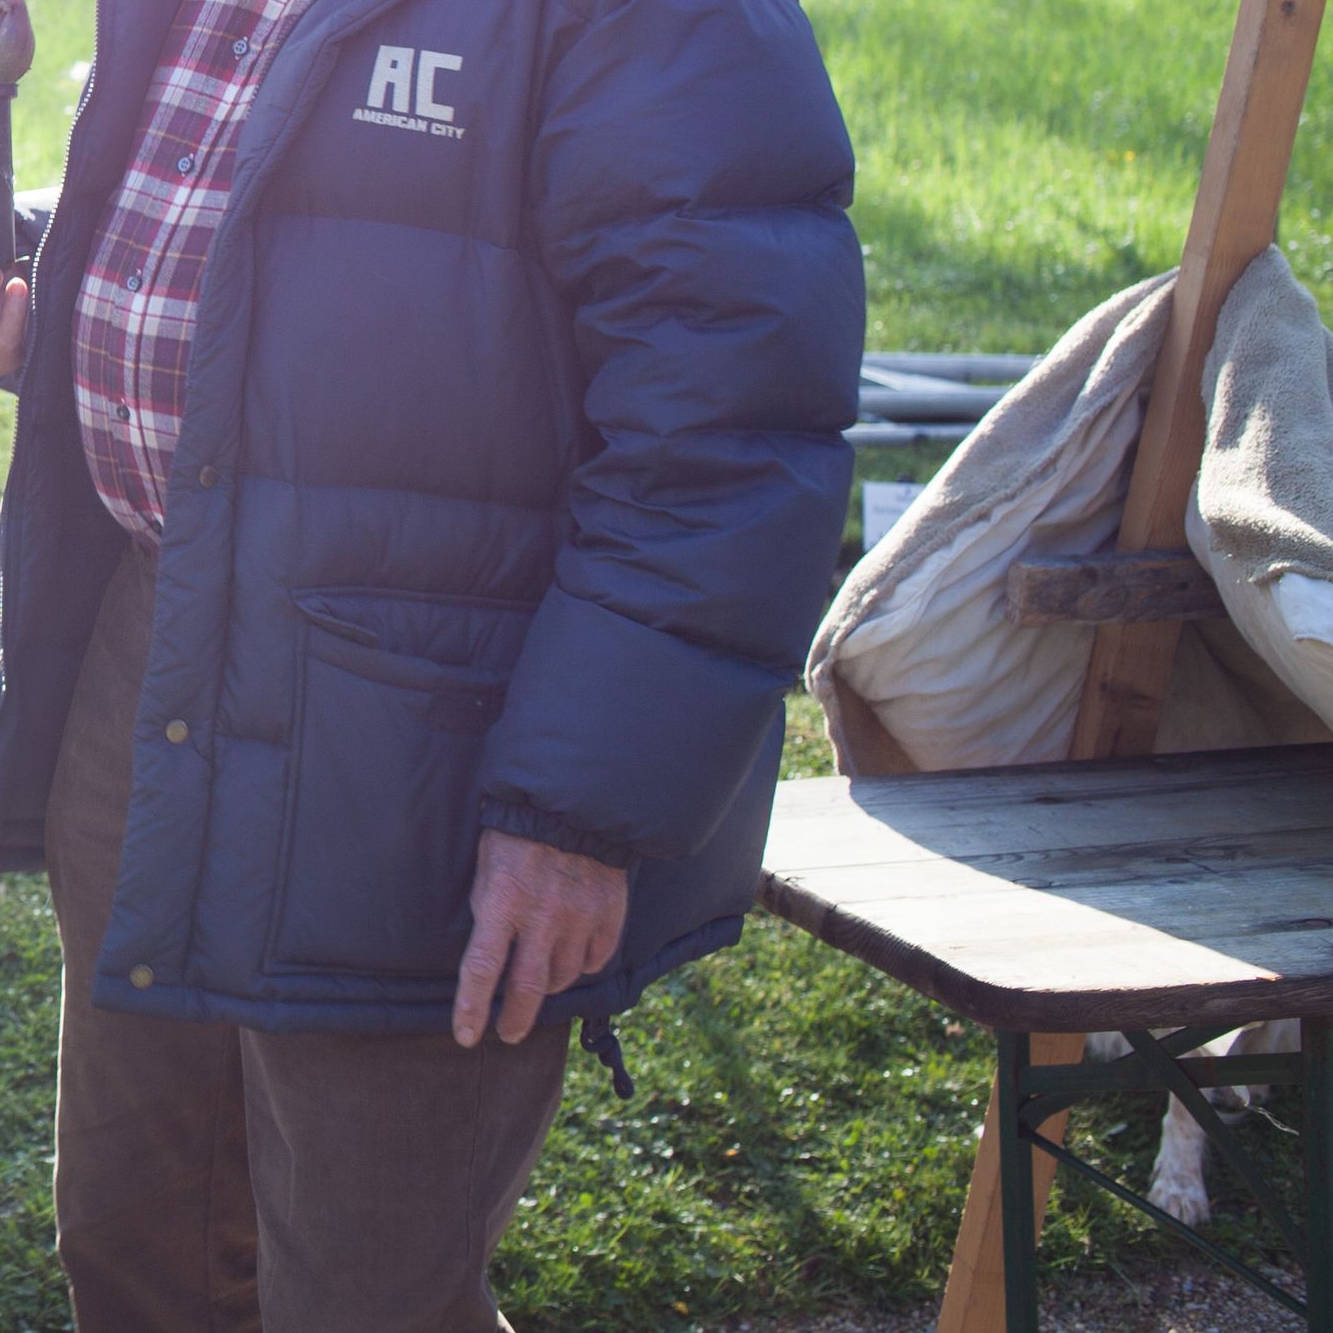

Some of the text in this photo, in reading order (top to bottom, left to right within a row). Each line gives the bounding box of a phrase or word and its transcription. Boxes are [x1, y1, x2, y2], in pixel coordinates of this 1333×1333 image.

[366, 45, 463, 122] AC
[352, 108, 465, 139] AMERICAN CITY
